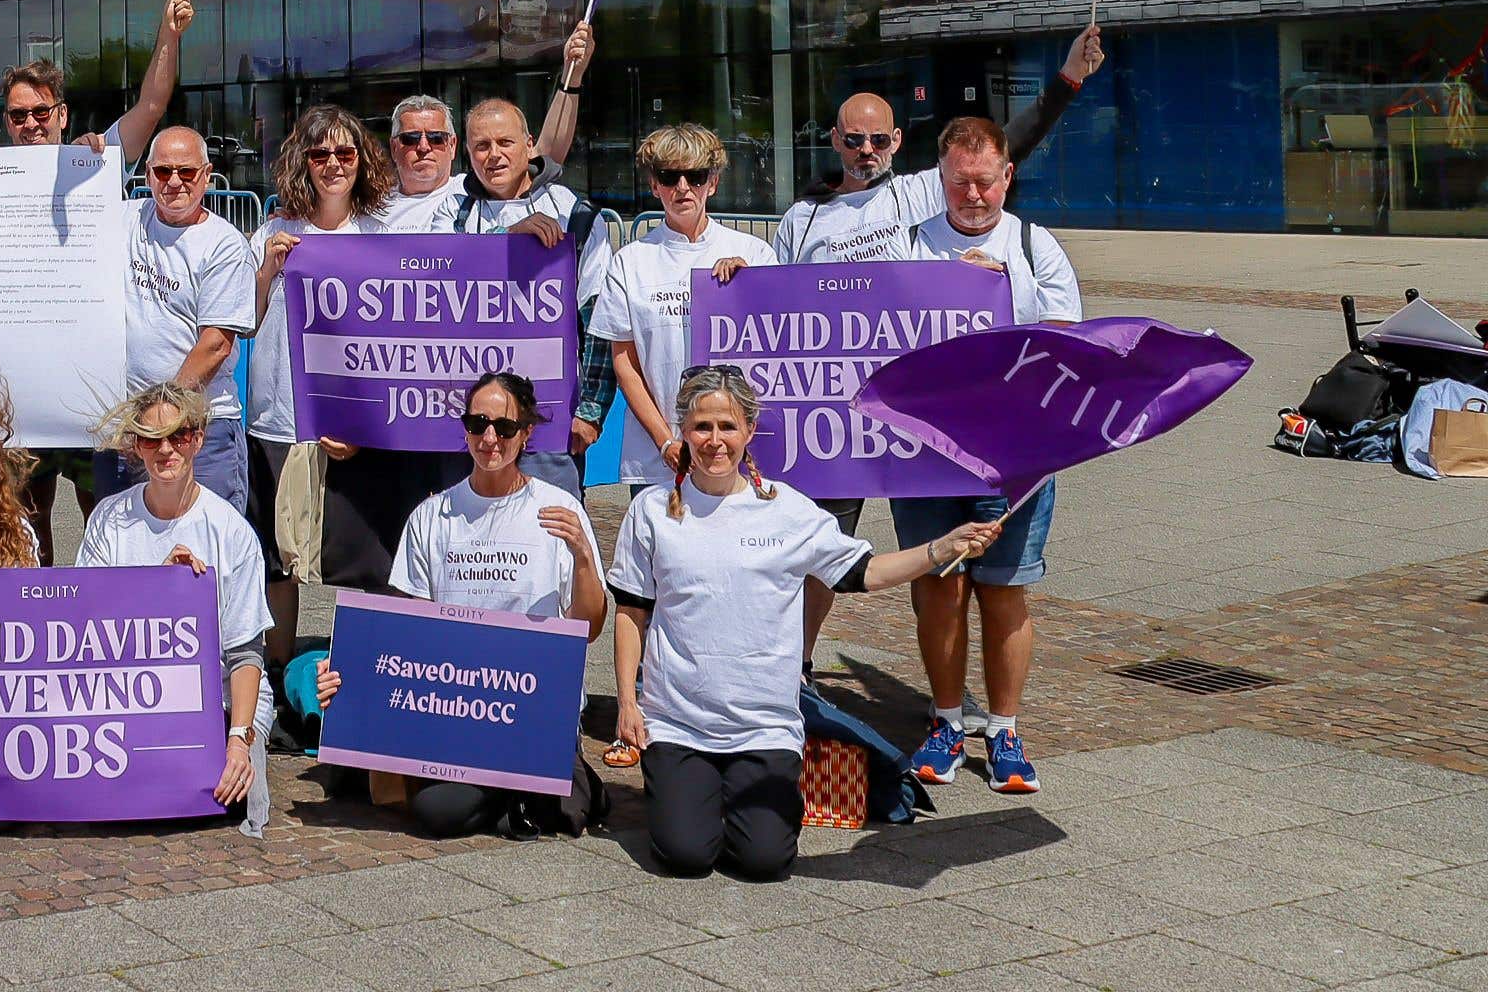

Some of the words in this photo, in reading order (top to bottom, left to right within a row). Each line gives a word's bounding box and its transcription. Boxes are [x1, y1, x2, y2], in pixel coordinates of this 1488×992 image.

[71, 158, 108, 168] EQUITY
[400, 258, 453, 270] EQUITY
[818, 278, 873, 292] EQUITY
[301, 277, 349, 329] JO
[357, 278, 563, 324] STEVENS
[709, 312, 832, 353] DAVID
[344, 343, 416, 373] SAVE
[423, 344, 515, 374] WNO!
[750, 362, 844, 397] SAVE
[386, 386, 466, 425] JOBS
[782, 407, 923, 473] JOBS
[740, 537, 785, 547] EQUITY
[448, 567, 518, 582] #AchubOCC
[21, 585, 80, 599] EQUITY
[440, 606, 485, 620] EQUITY
[46, 616, 200, 662] DAVIES
[57, 670, 163, 712] WNO
[375, 654, 537, 695] #SaveOurWNO
[389, 688, 516, 725] #AchubOCC
[422, 764, 468, 778] EQUITY
